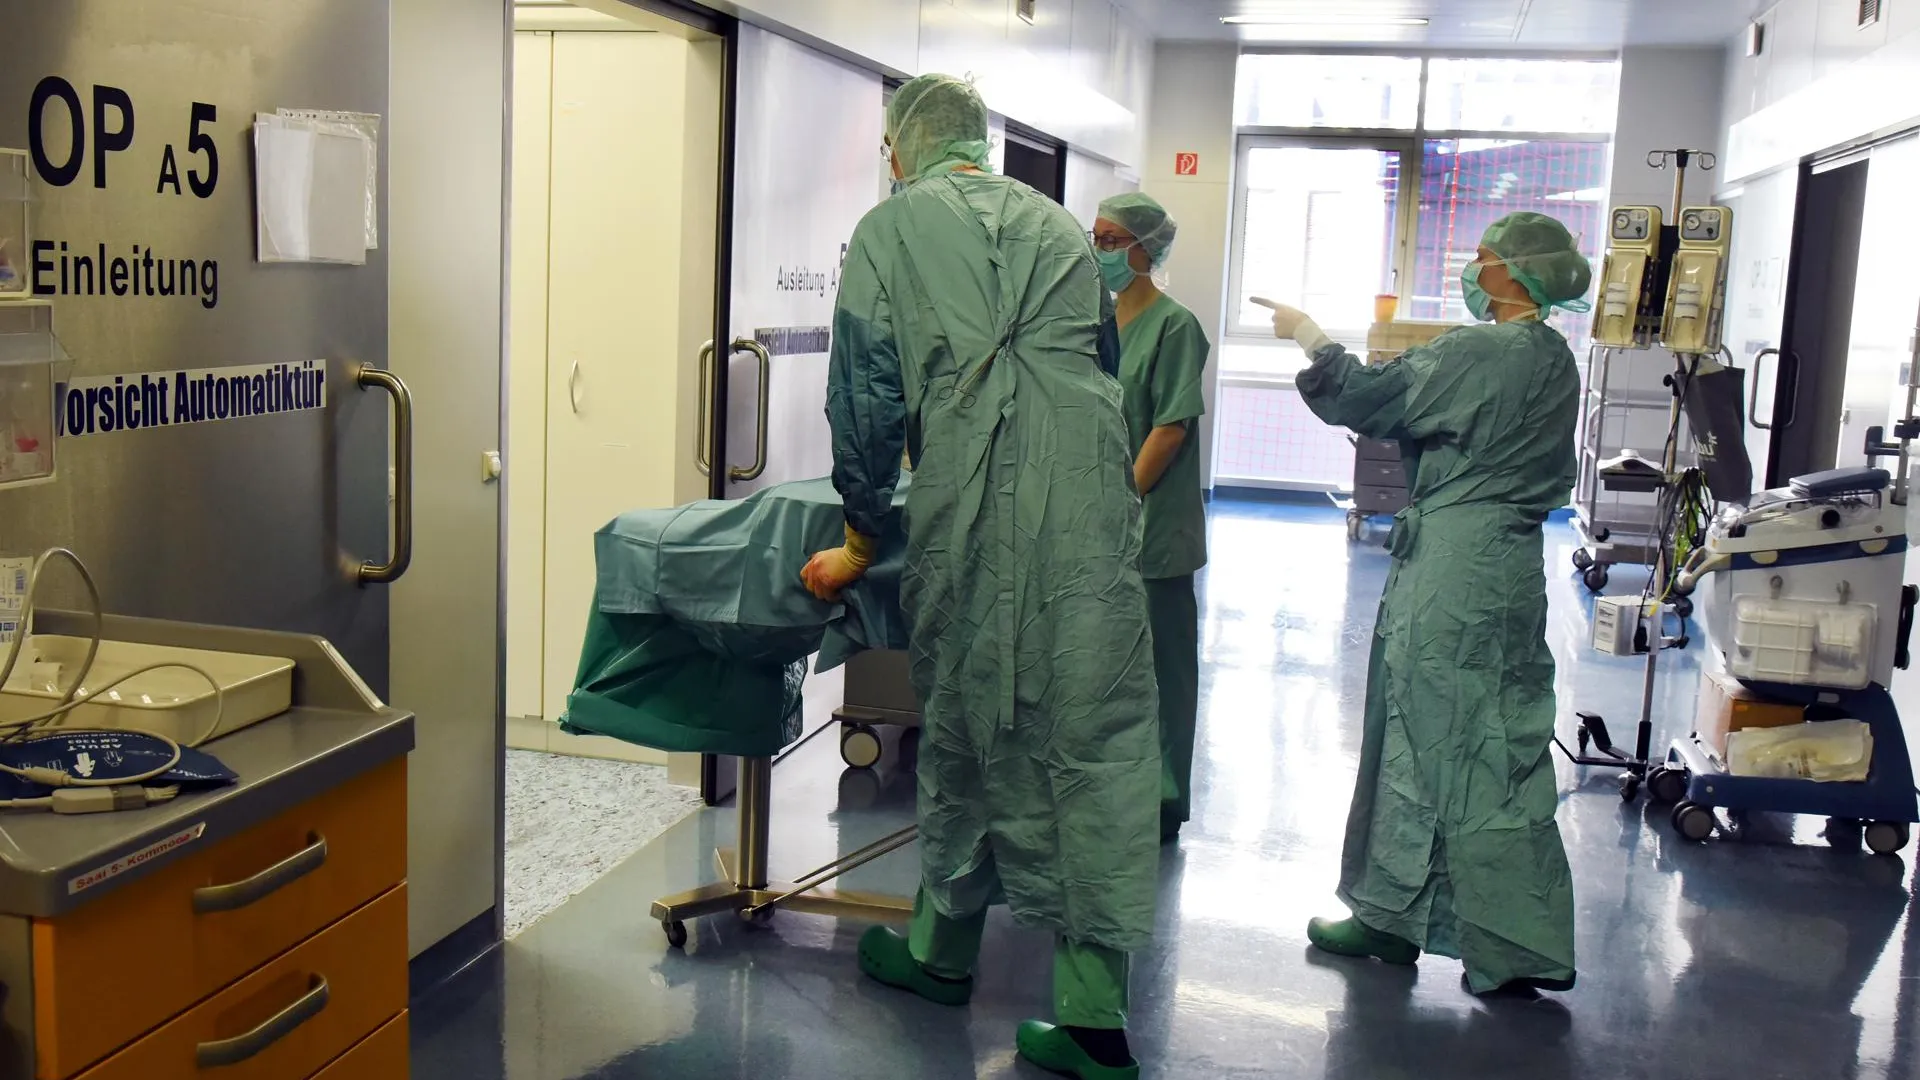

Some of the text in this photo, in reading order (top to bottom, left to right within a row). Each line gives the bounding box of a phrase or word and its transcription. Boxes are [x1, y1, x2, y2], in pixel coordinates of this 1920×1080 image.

[28, 76, 135, 189] OP
[32, 239, 219, 309] Einleitung
[776, 265, 826, 298] Ausleitung
[173, 360, 324, 424] Automatiktür
[67, 743, 122, 752] ADULT
[75, 870, 107, 890] Saal
